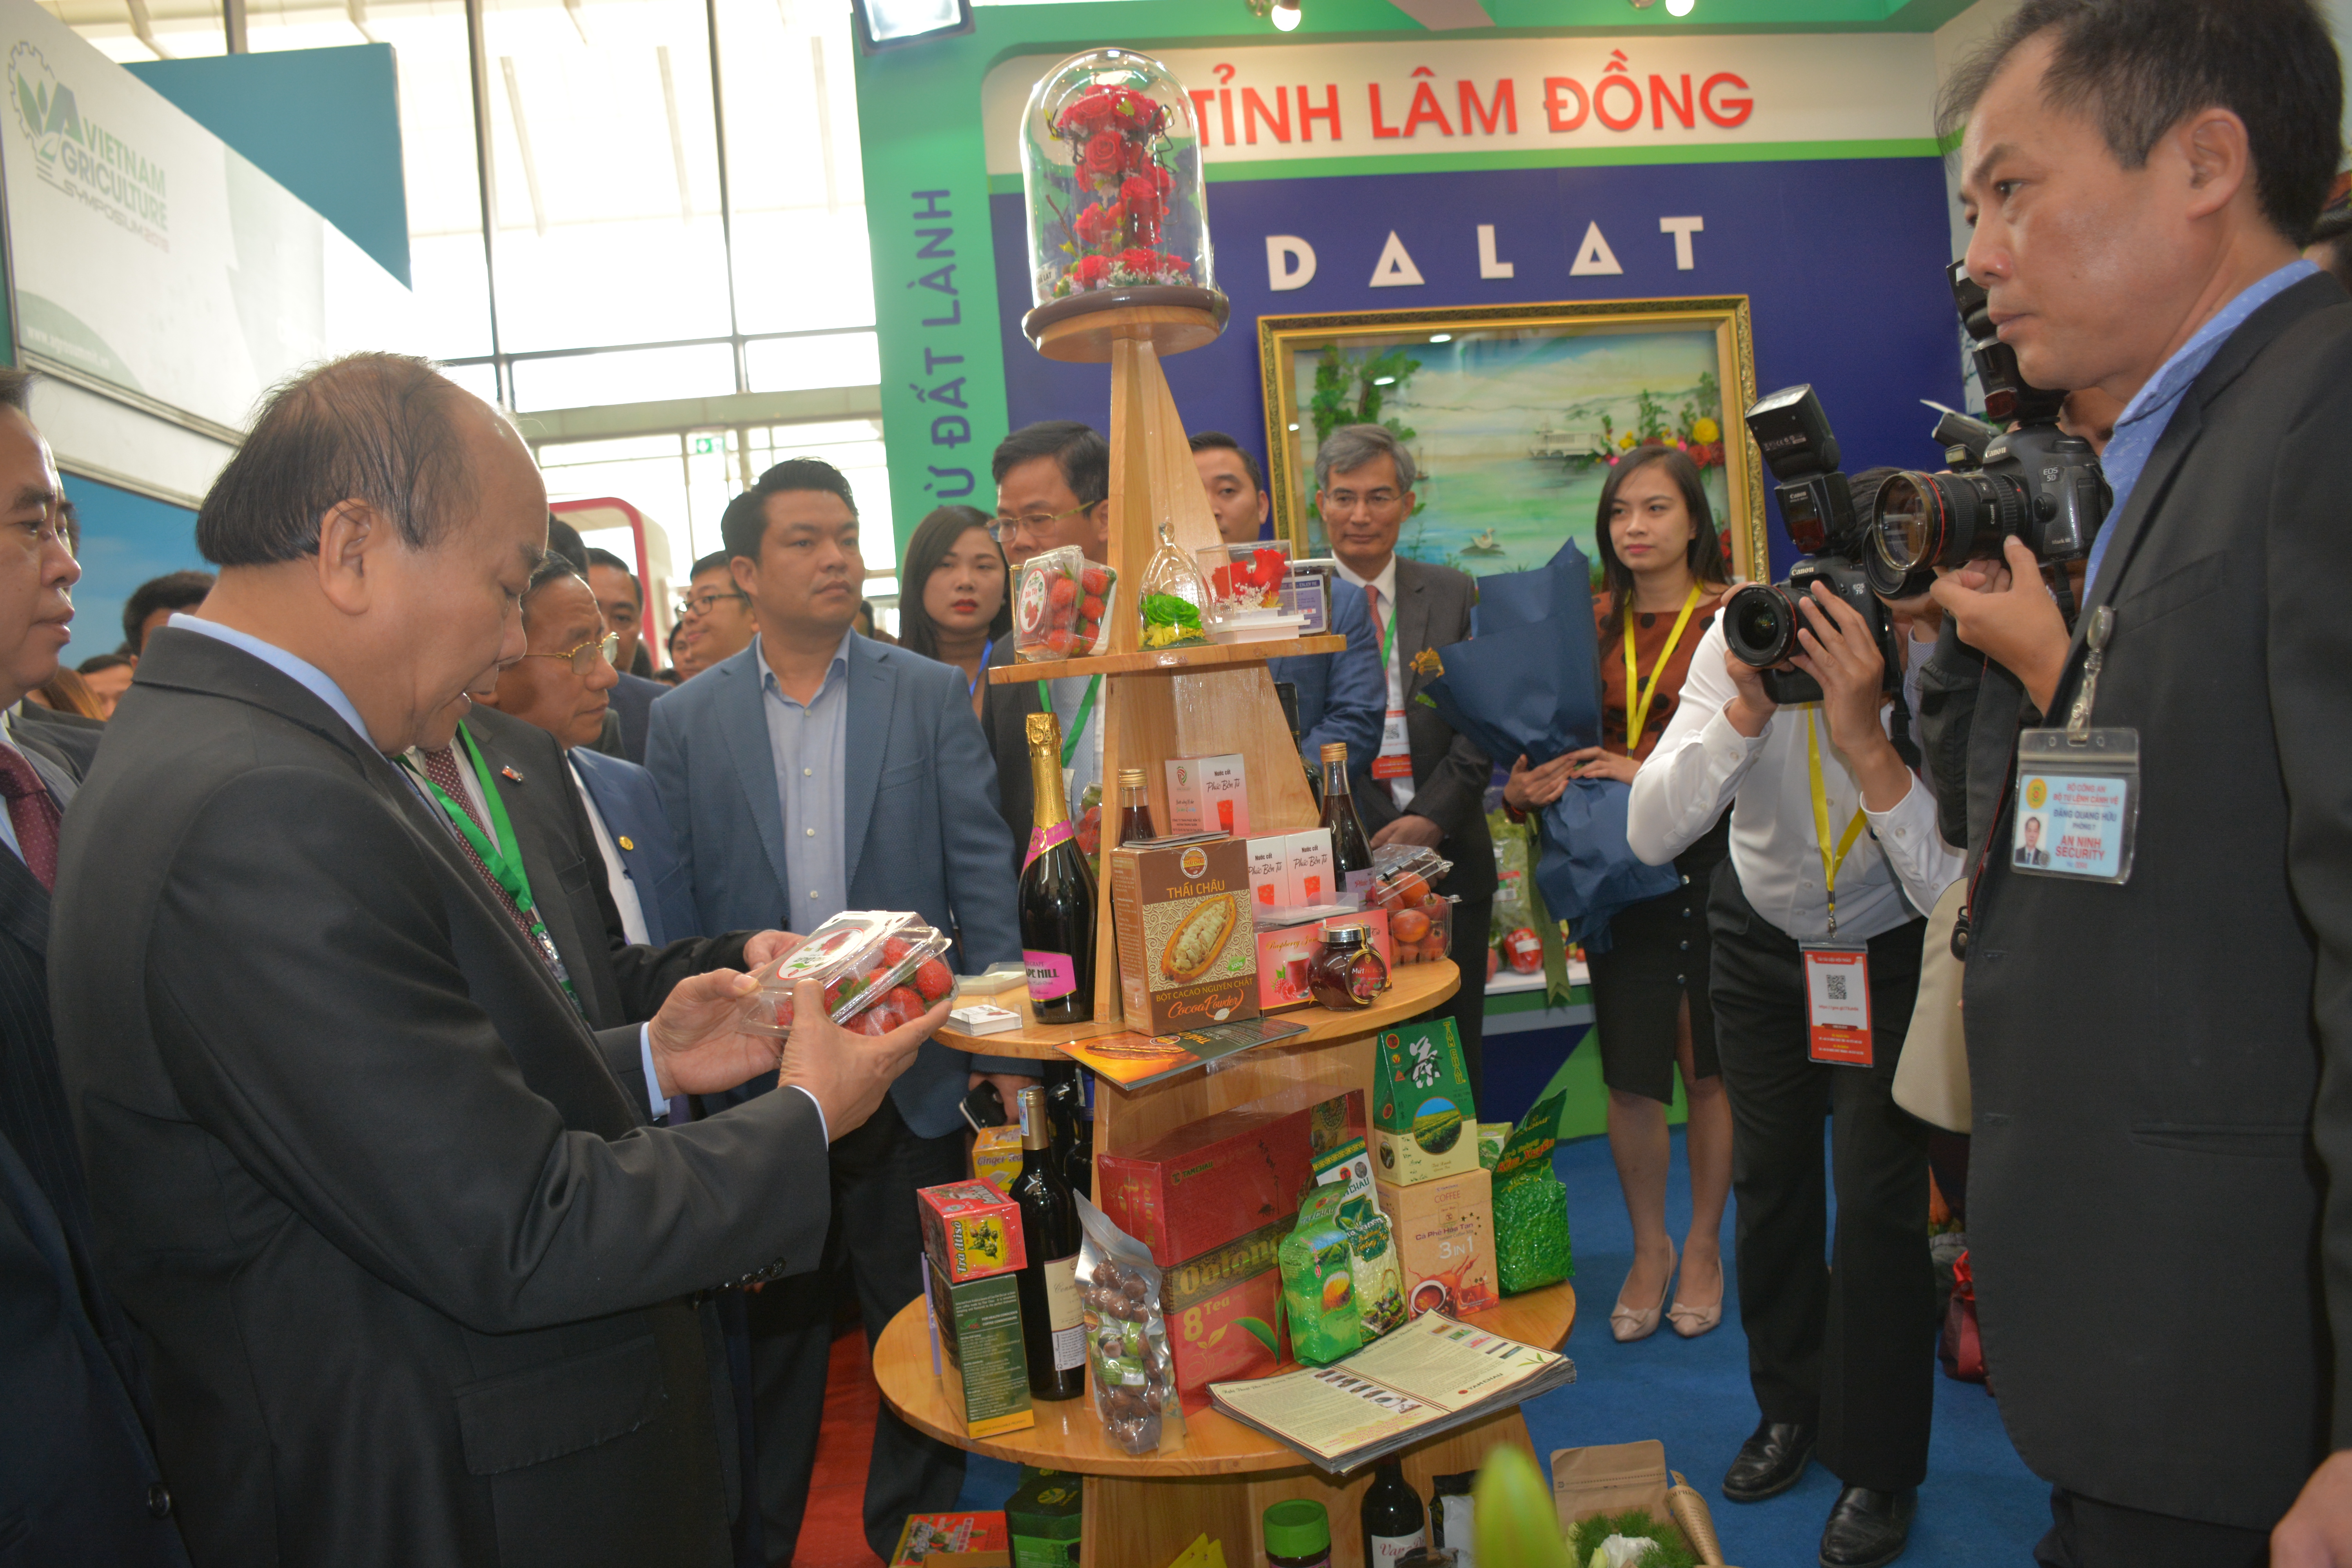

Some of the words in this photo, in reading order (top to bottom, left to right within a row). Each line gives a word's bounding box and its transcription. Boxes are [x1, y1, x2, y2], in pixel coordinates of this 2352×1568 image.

[1188, 63, 1342, 146] TỈNH
[1368, 65, 1518, 140] LÂM
[1543, 48, 1754, 133] ĐỒNG
[83, 117, 166, 199] VIETNAM
[907, 189, 962, 327] LÀNH
[909, 346, 971, 450] ĐẤT
[1985, 446, 2006, 459] Canon
[2043, 467, 2058, 475] EOS
[923, 465, 976, 511] Ừ
[1791, 566, 1815, 576] Canon
[2077, 783, 2095, 793] CÔNG
[2074, 811, 2100, 820] QUANG
[2061, 835, 2074, 846] AN
[2077, 836, 2102, 849] NINH
[2055, 846, 2105, 861] SECURITY
[1166, 882, 1193, 899] THÁI
[1196, 878, 1225, 895] CHÂU
[1266, 940, 1300, 952] Raspberry
[1231, 960, 1243, 970] 500g
[1156, 992, 1172, 1002] BỘT
[1173, 988, 1201, 999] CACAO
[1202, 982, 1233, 994] NGUYÊN
[1234, 978, 1253, 988] CHẤT
[977, 1156, 1007, 1167] Ginger
[1008, 1153, 1023, 1163] Tea
[1497, 1156, 1520, 1173] Kim
[1524, 1138, 1555, 1159] Xuyên
[1434, 1190, 1461, 1203] COFFEE
[951, 1221, 965, 1252] Atisô
[1416, 1231, 1426, 1241] Cà
[1427, 1229, 1442, 1238] Phê
[1459, 1222, 1474, 1230] Tan
[1439, 1241, 1452, 1259] 3
[1454, 1244, 1466, 1256] IN
[1466, 1236, 1474, 1253] 1
[955, 1253, 967, 1274] Trà
[1180, 1232, 1287, 1295] Oolong
[994, 1316, 1018, 1324] CONNOISSEURS
[1183, 1307, 1203, 1342] 8
[1203, 1296, 1230, 1315] Tea
